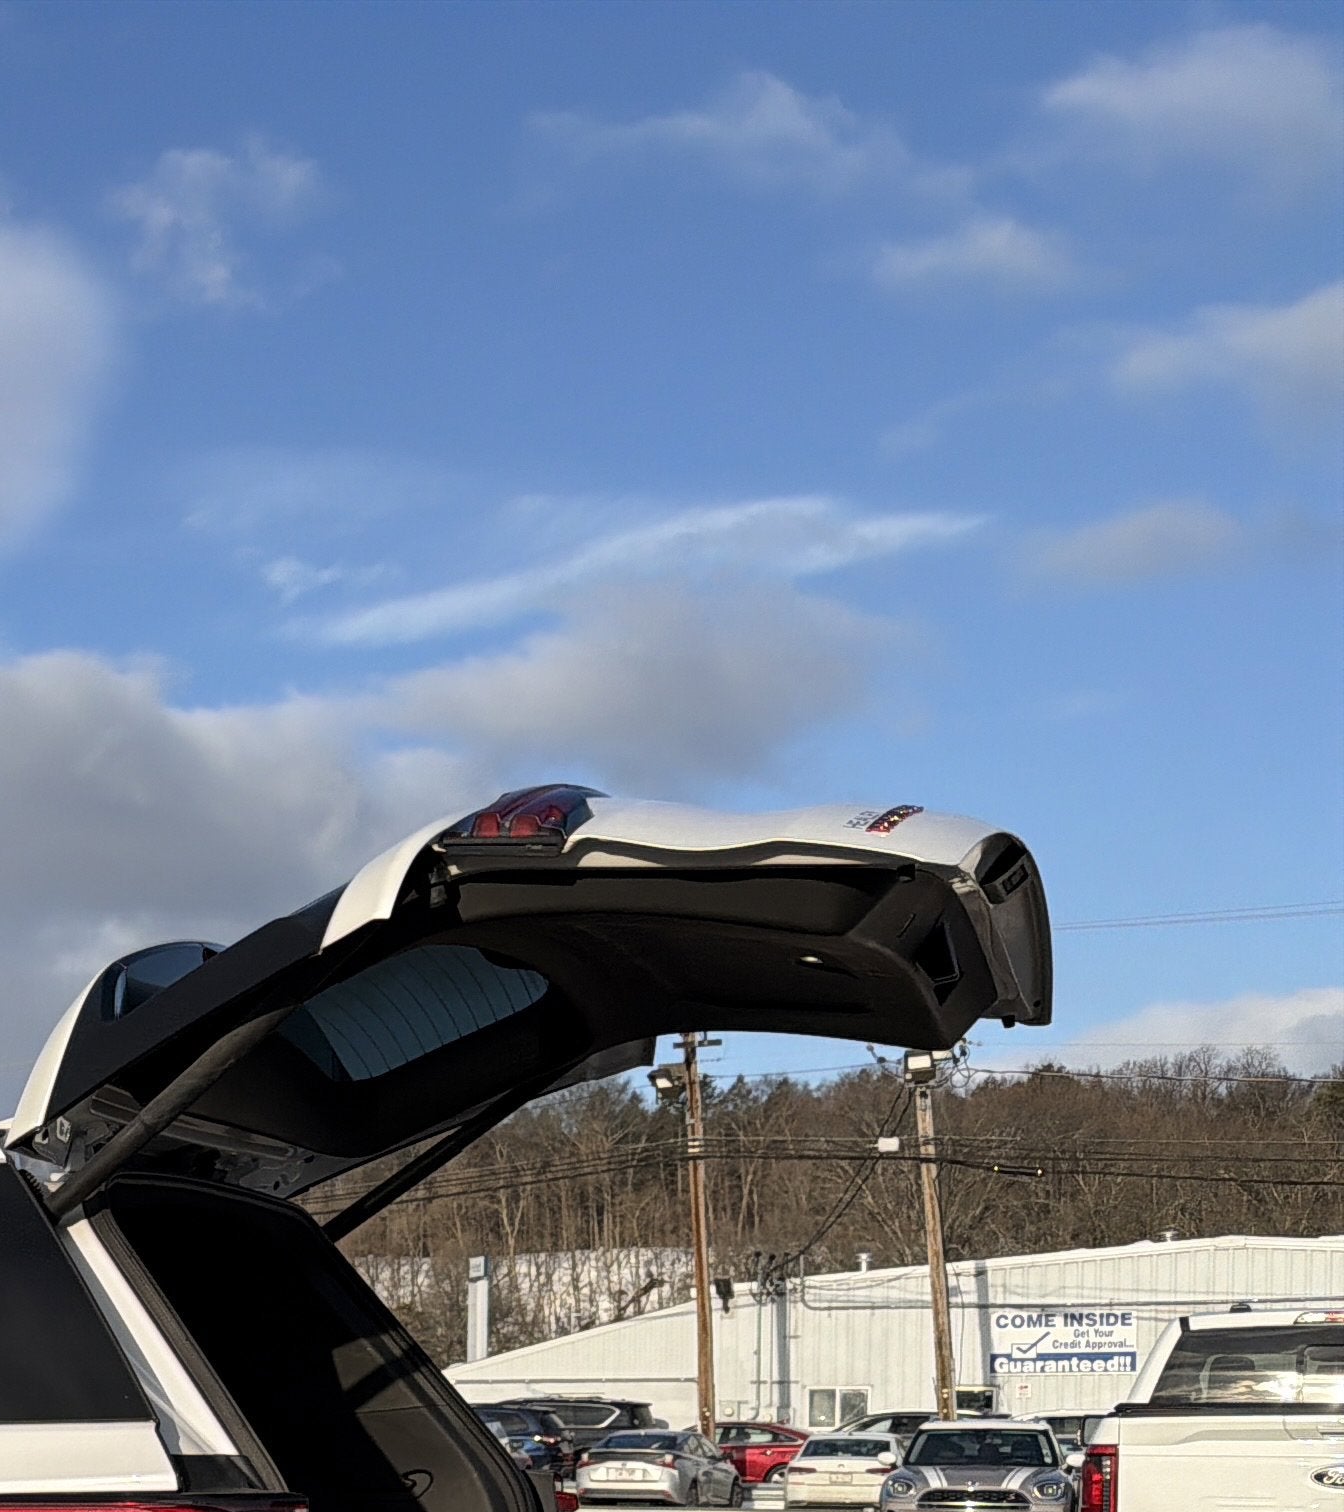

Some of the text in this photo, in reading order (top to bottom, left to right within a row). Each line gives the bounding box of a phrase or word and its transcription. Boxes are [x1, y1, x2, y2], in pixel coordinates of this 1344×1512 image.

[995, 1312, 1133, 1329] COME INSIDE
[1073, 1328, 1114, 1338] Get Your
[1052, 1339, 1082, 1349] Credit
[994, 1355, 1132, 1373] Guaranteed!!
